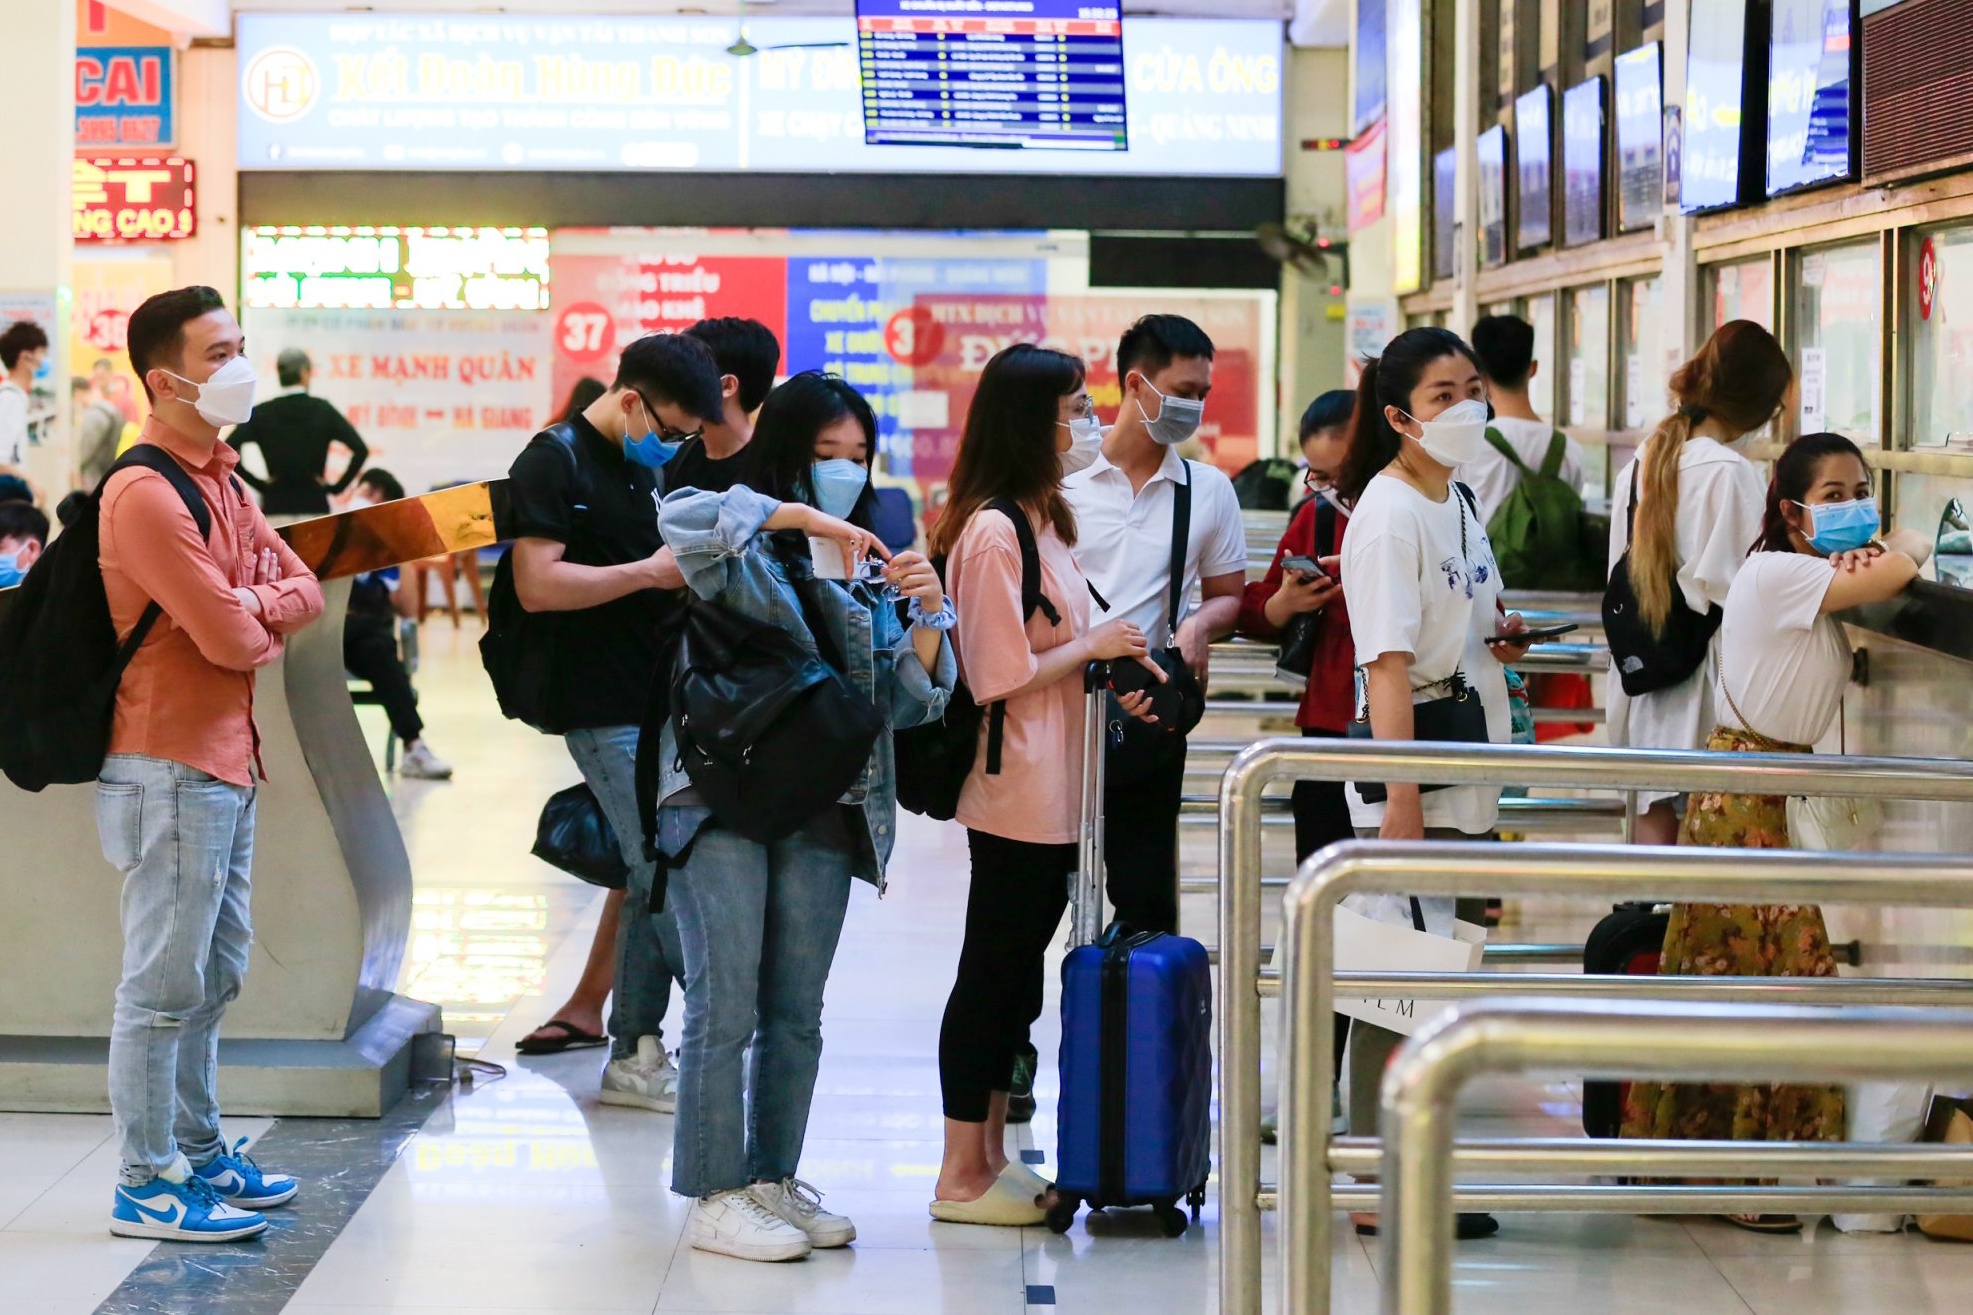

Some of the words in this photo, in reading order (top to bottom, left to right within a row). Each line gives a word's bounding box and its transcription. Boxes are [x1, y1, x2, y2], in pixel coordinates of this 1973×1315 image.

[1208, 45, 1278, 94] ÔNG
[563, 313, 608, 351] 37
[371, 354, 449, 387] MẠNH
[458, 349, 537, 386] QUÂN
